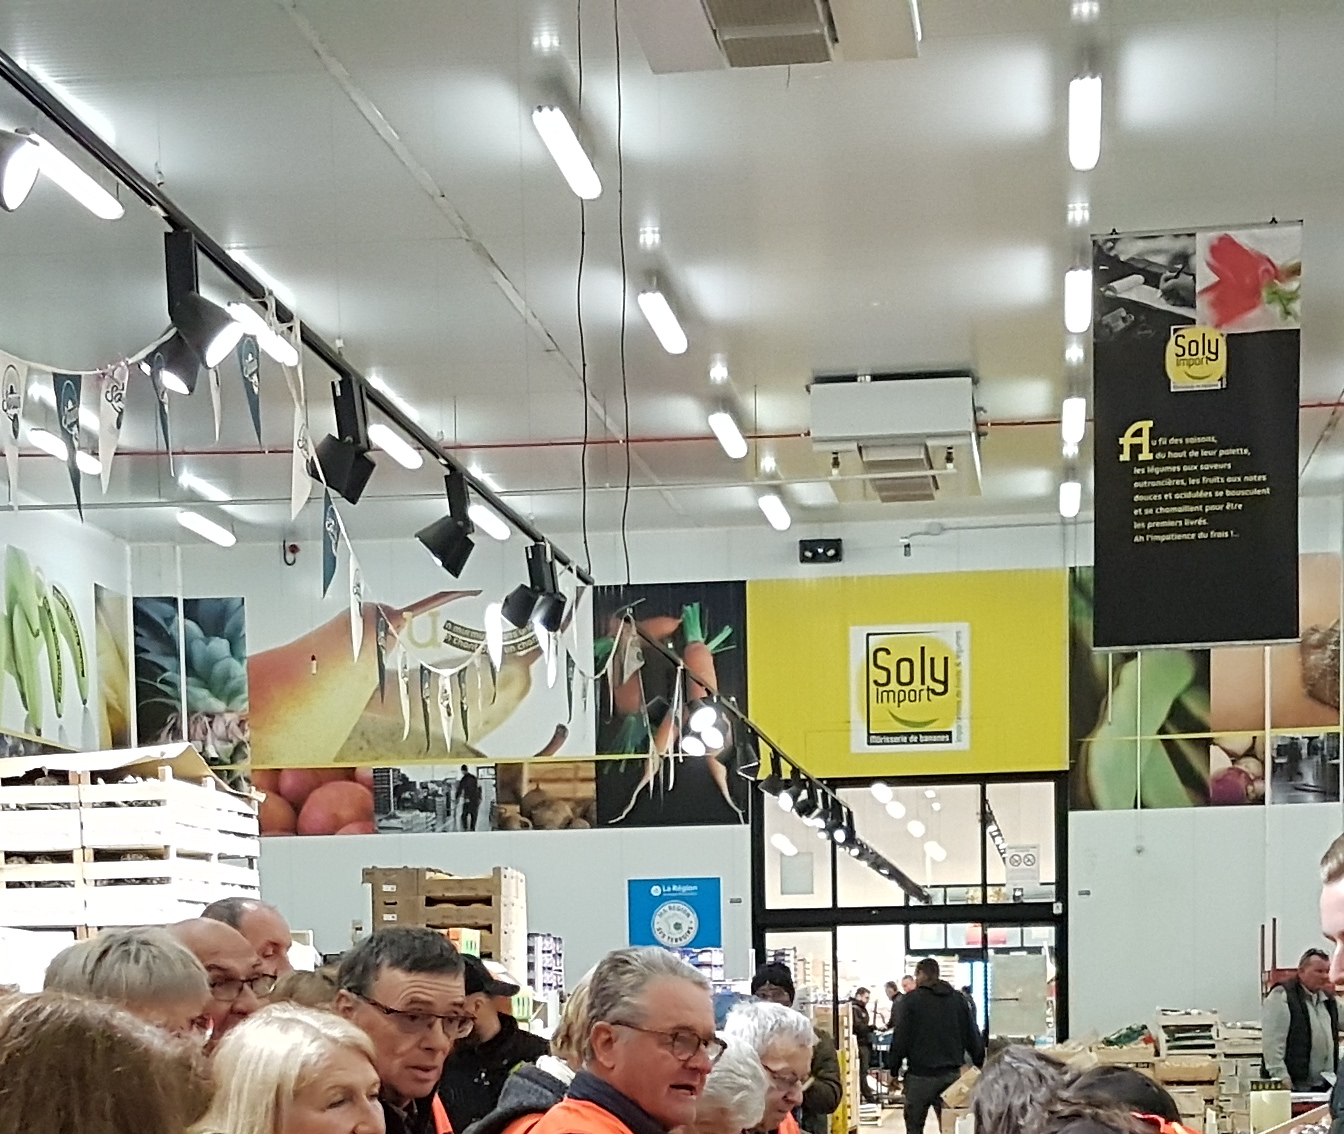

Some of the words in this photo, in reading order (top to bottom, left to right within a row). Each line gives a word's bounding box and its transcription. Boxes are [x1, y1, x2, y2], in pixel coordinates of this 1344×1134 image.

[1174, 333, 1219, 362] Soly
[1185, 436, 1217, 444] saisons,
[1168, 450, 1186, 458] haut
[1189, 449, 1199, 457] de
[1219, 447, 1251, 457] palette,
[1147, 465, 1181, 475] légumes
[1183, 464, 1198, 472] aux
[1200, 462, 1231, 471] saveurs
[1203, 476, 1224, 484] fruits
[1227, 475, 1241, 483] aux
[1244, 474, 1266, 482] notes
[1134, 493, 1162, 502] douces
[1174, 491, 1212, 500] acidulées
[1226, 488, 1270, 497] bousculent
[1156, 505, 1203, 514] chamaillent
[1205, 504, 1224, 513] pour
[1226, 502, 1242, 510] être
[1134, 521, 1145, 529] les
[1147, 519, 1182, 529] premiers
[1185, 518, 1208, 526] livrés.
[1147, 533, 1196, 543] l'impatience
[873, 646, 948, 696] Soly
[673, 884, 698, 892] Région
